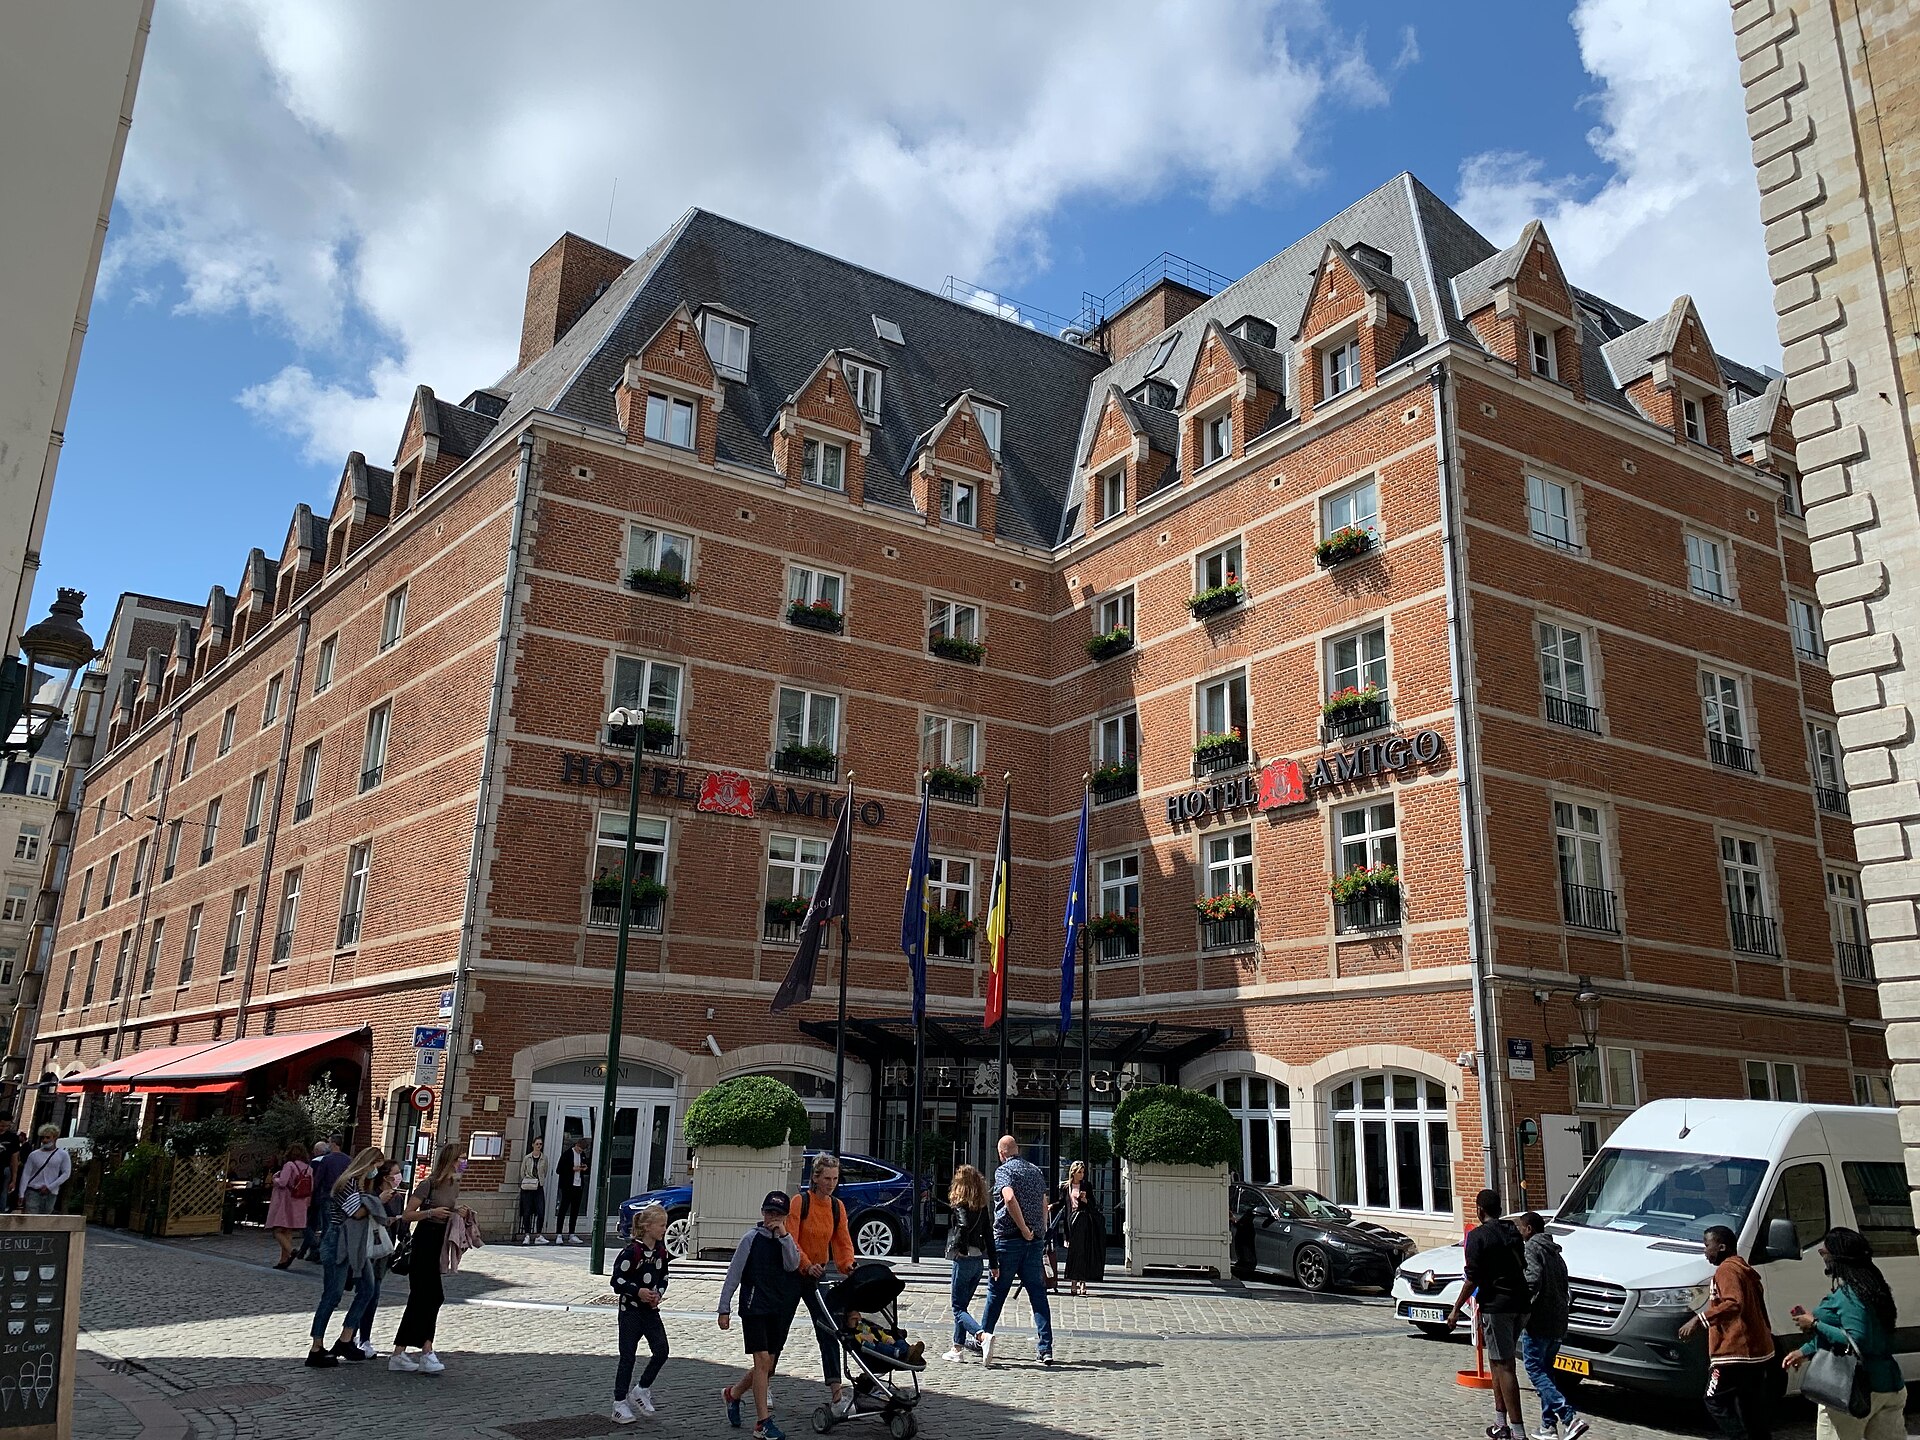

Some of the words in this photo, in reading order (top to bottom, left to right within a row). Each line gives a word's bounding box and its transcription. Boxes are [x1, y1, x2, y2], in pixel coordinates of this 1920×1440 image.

[560, 751, 697, 800] HOEL
[1164, 776, 1258, 823] HOTEL
[1310, 730, 1443, 789] AMIGO
[883, 1066, 968, 1088] HOEL
[1023, 1068, 1136, 1093] AMGO
[0, 1238, 30, 1250] ENU
[1554, 1356, 1583, 1372] 77-XZ
